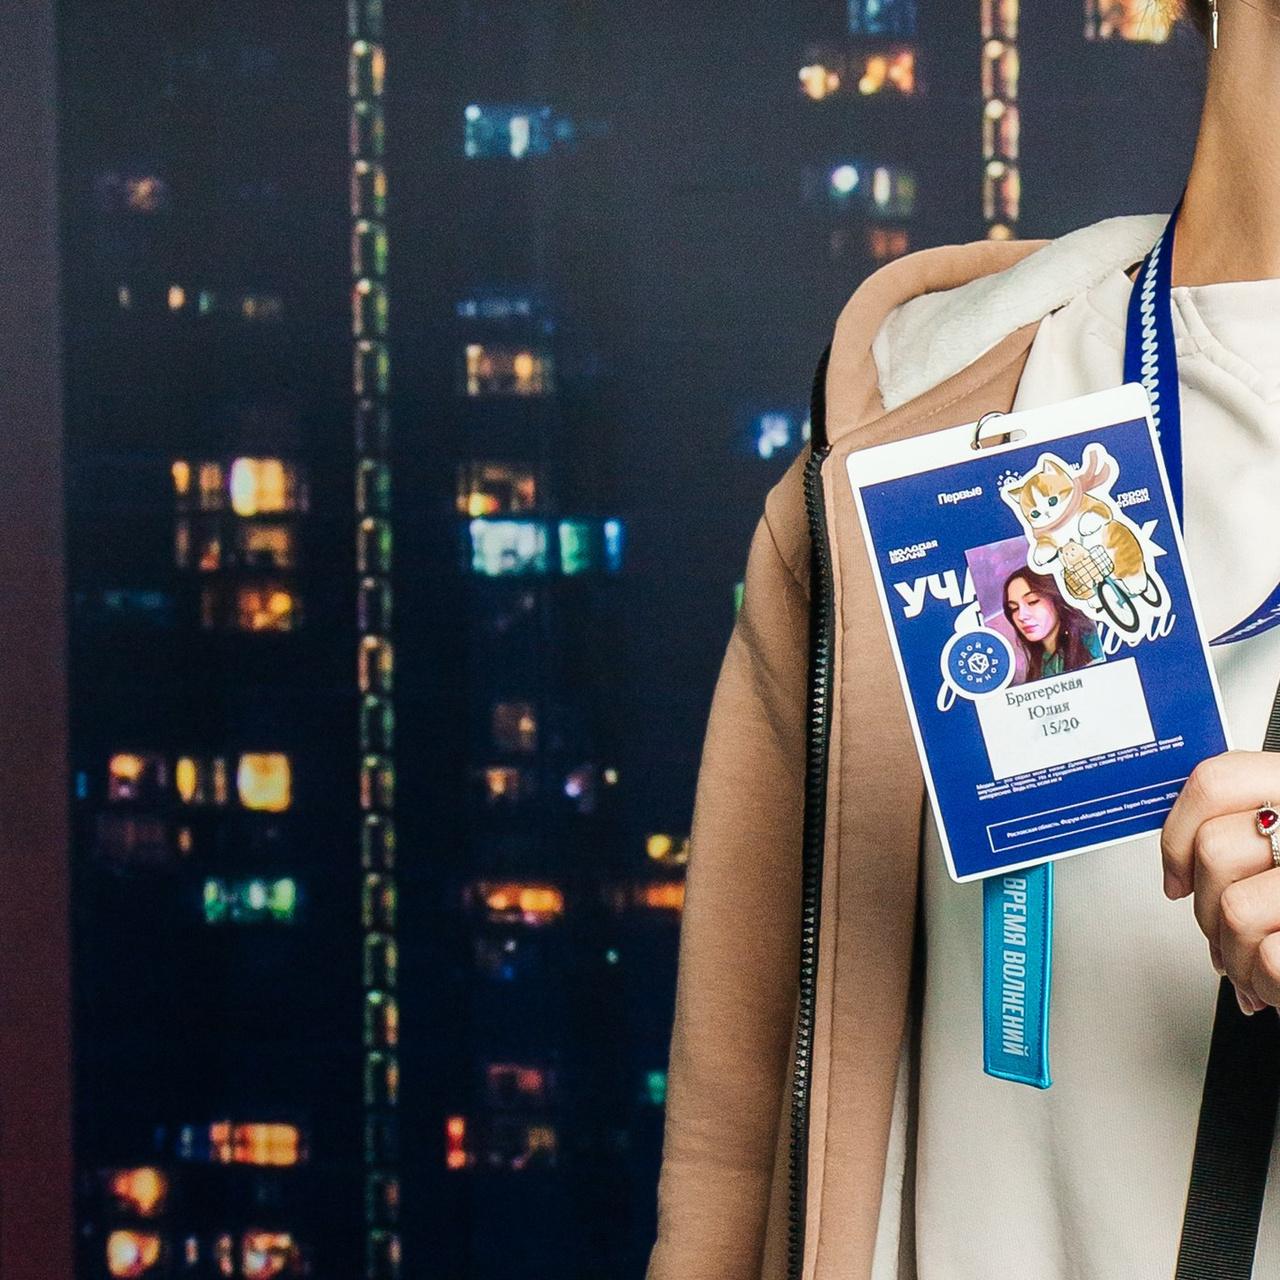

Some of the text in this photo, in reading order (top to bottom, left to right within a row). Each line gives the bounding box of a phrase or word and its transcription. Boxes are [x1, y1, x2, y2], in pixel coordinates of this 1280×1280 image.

[937, 486, 983, 505] Первые
[889, 540, 938, 556] молодая
[1005, 677, 1083, 707] Братерская
[1027, 702, 1070, 720] Юлия
[1042, 717, 1079, 737] 15/20
[1002, 876, 1029, 1057] ВРЕМЯ ВОЛНЕНИЙ
